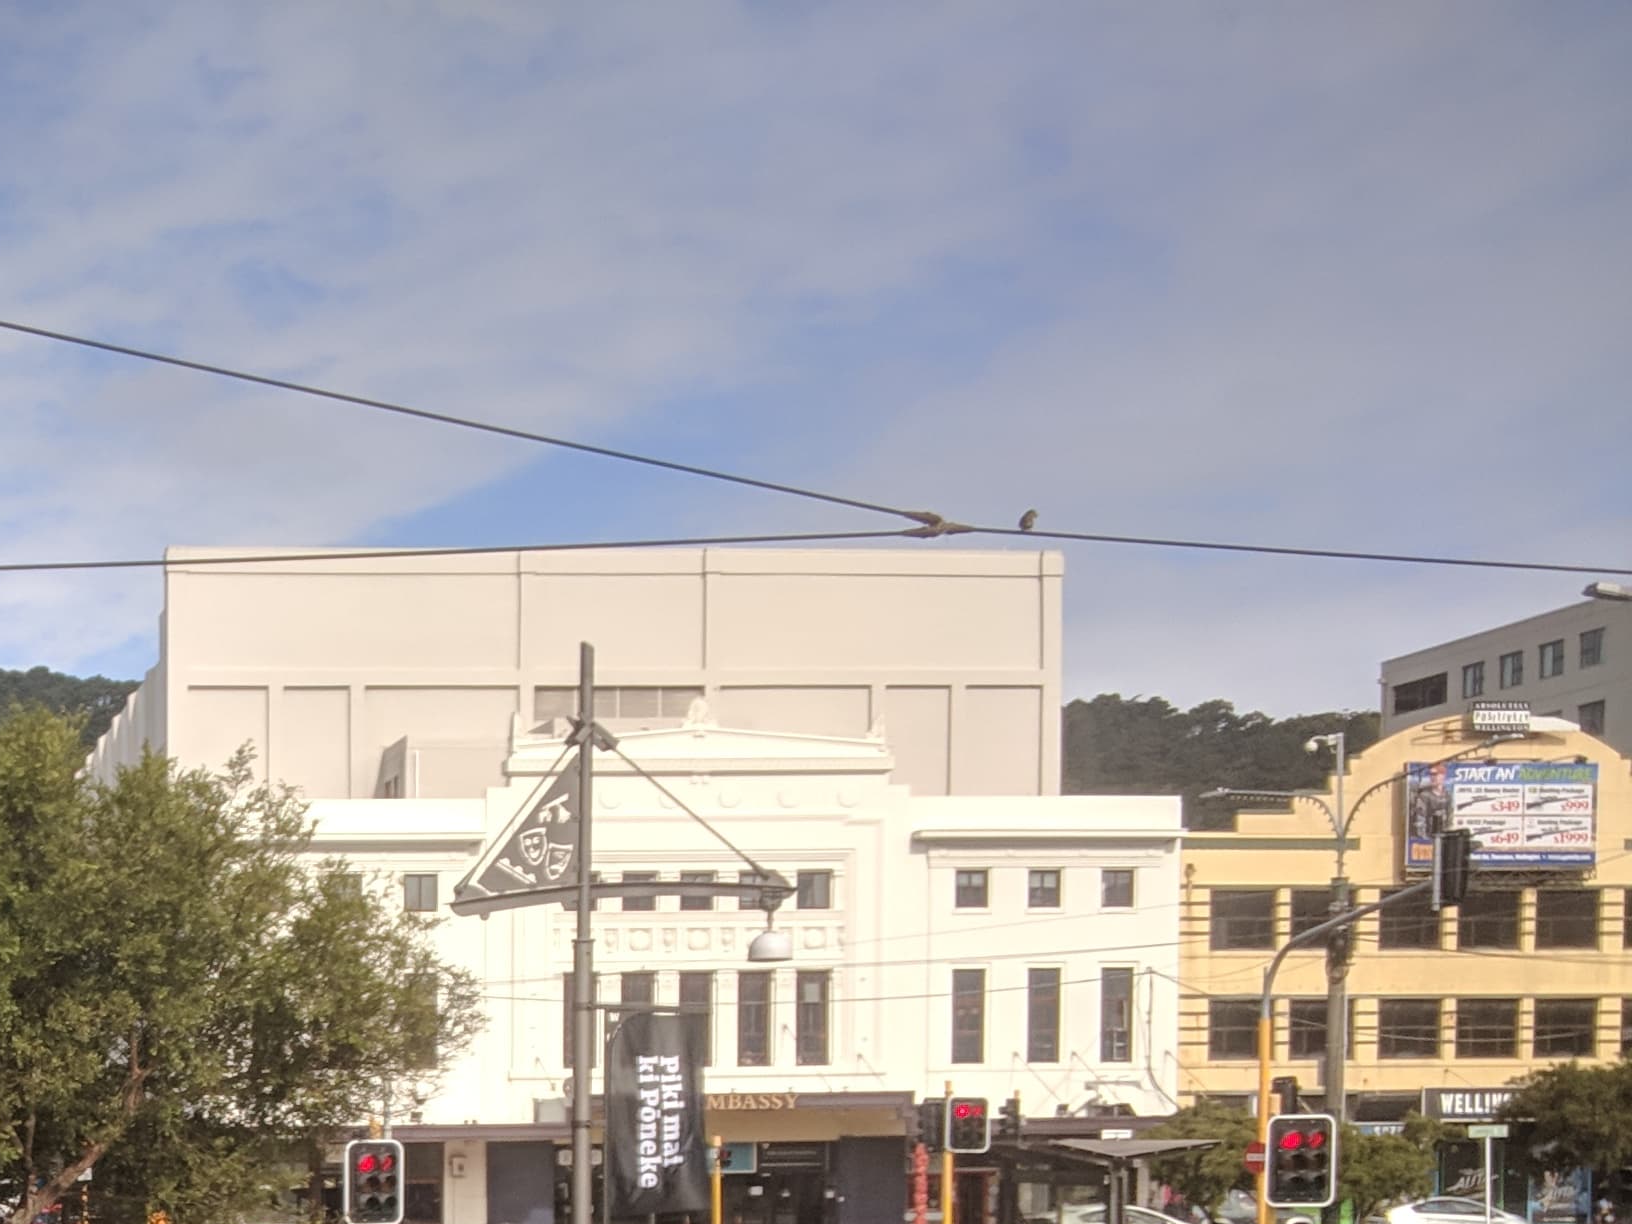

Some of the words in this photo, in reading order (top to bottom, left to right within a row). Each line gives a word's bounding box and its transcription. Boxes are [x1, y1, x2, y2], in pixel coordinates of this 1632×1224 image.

[1454, 767, 1492, 782] START
[1495, 766, 1517, 782] AN
[1519, 767, 1592, 781] ADVENTURE
[1490, 800, 1519, 812] $349
[1560, 801, 1589, 812] $999
[1490, 832, 1519, 844] $649
[1553, 833, 1589, 844] $1999
[637, 1055, 660, 1084] ki
[659, 1054, 685, 1110] Piki
[638, 1088, 662, 1188] Pōneke
[662, 1114, 685, 1168] mai
